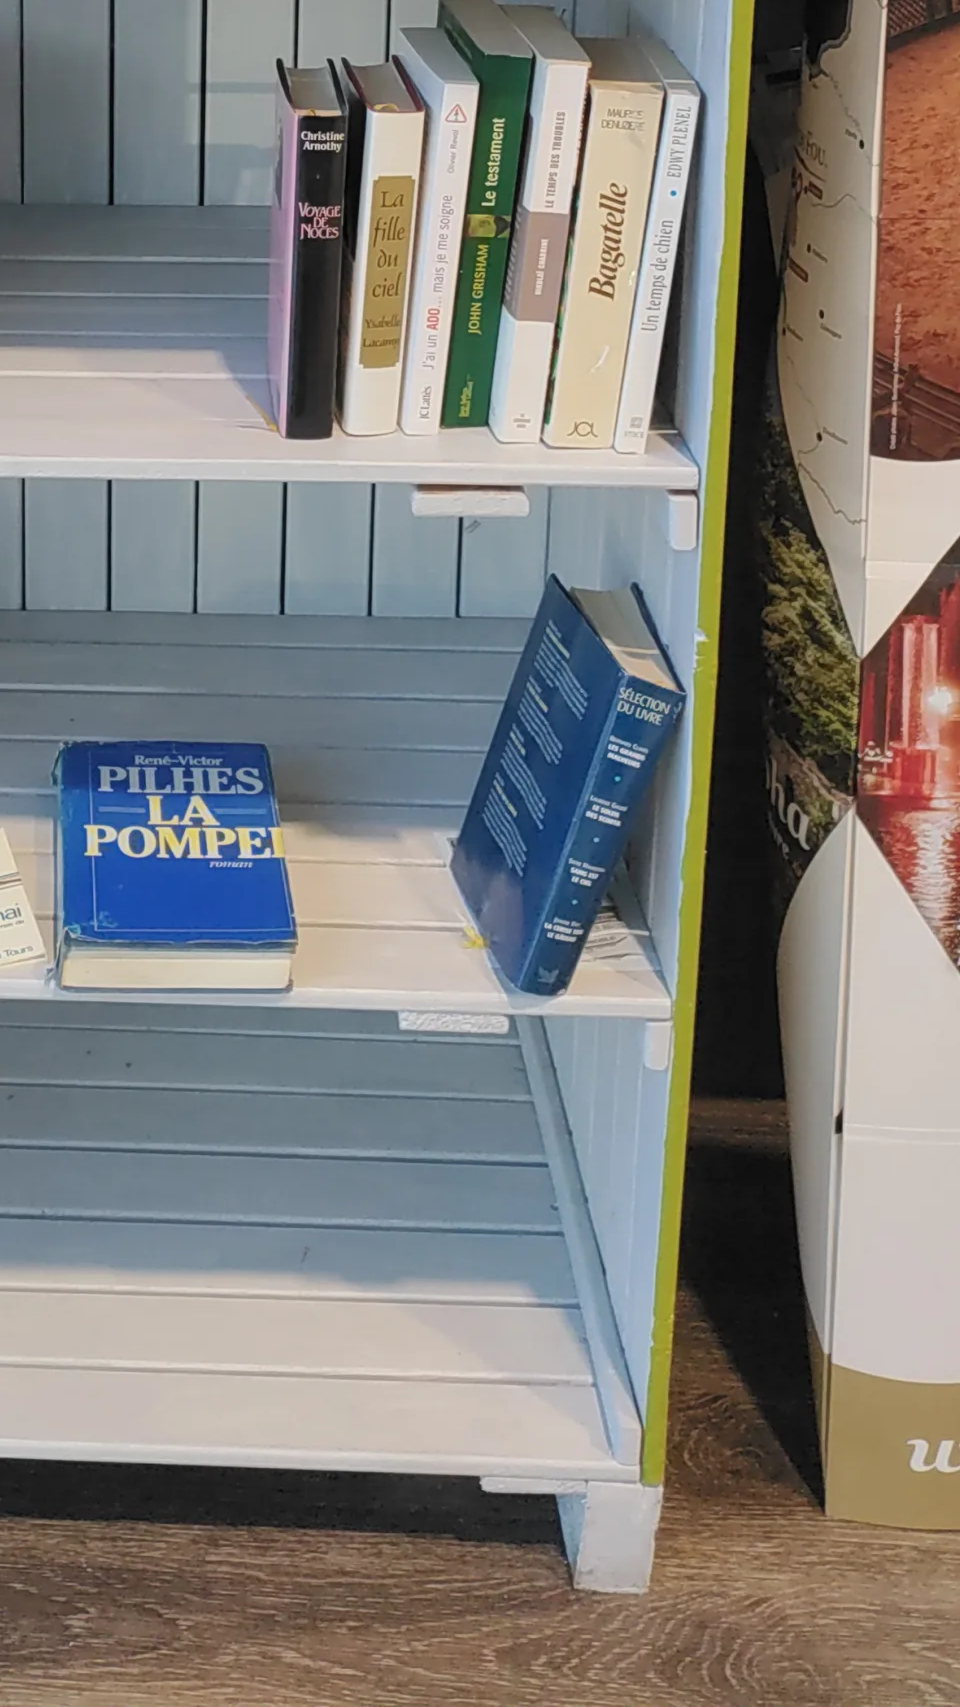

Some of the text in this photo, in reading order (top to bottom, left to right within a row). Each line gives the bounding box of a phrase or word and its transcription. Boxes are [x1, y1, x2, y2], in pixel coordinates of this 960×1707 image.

[301, 131, 345, 141] Christine
[303, 142, 342, 153] Arnothy
[666, 104, 691, 178] EDWY PLENEL
[481, 116, 505, 208] Le testament
[544, 111, 566, 208] LE TEMPS DES TROUBLES
[298, 202, 341, 218] VOYAGE
[380, 191, 404, 208] La
[300, 224, 339, 240] NOCES
[313, 217, 328, 228] DE
[373, 216, 405, 247] fille
[588, 182, 628, 302] Bagatelle
[377, 250, 398, 268] du
[372, 272, 401, 298] ciel
[641, 218, 674, 333] Un temps de chien
[467, 244, 490, 335] JOHN GRISHAM
[617, 701, 664, 726] DU LIVRE
[618, 687, 671, 715] SÉLECTION
[98, 766, 264, 794] PILHES
[147, 795, 220, 825] LA
[4, 945, 34, 957] Tours
